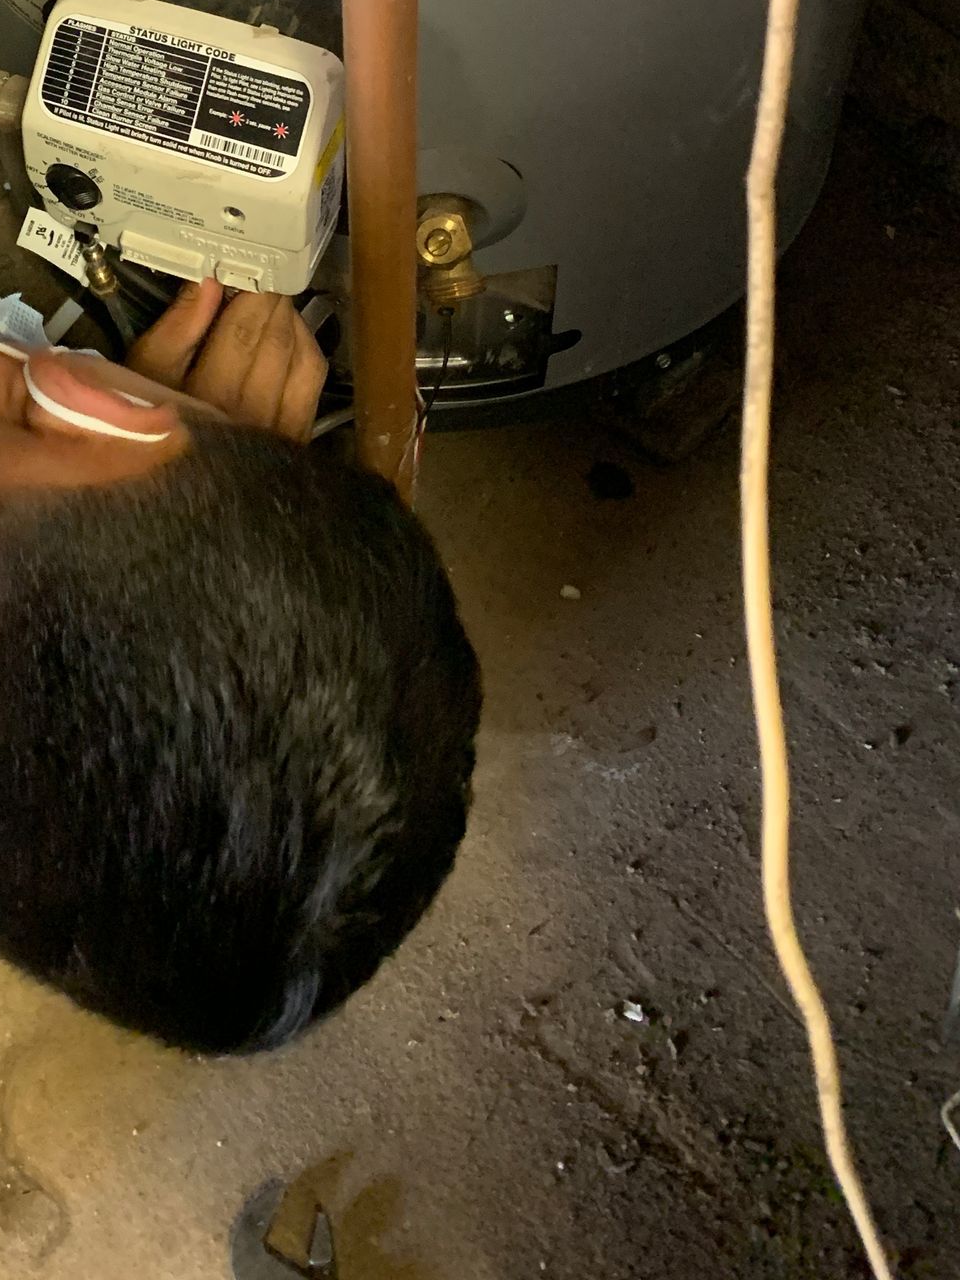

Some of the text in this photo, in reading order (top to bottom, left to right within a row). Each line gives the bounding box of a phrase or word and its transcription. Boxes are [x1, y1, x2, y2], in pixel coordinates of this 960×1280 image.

[68, 19, 97, 32] FLASHES
[109, 39, 165, 60] Normal Operation
[129, 25, 236, 61] STATUS LIGHT CODE
[105, 54, 166, 77] Slow Water Heating
